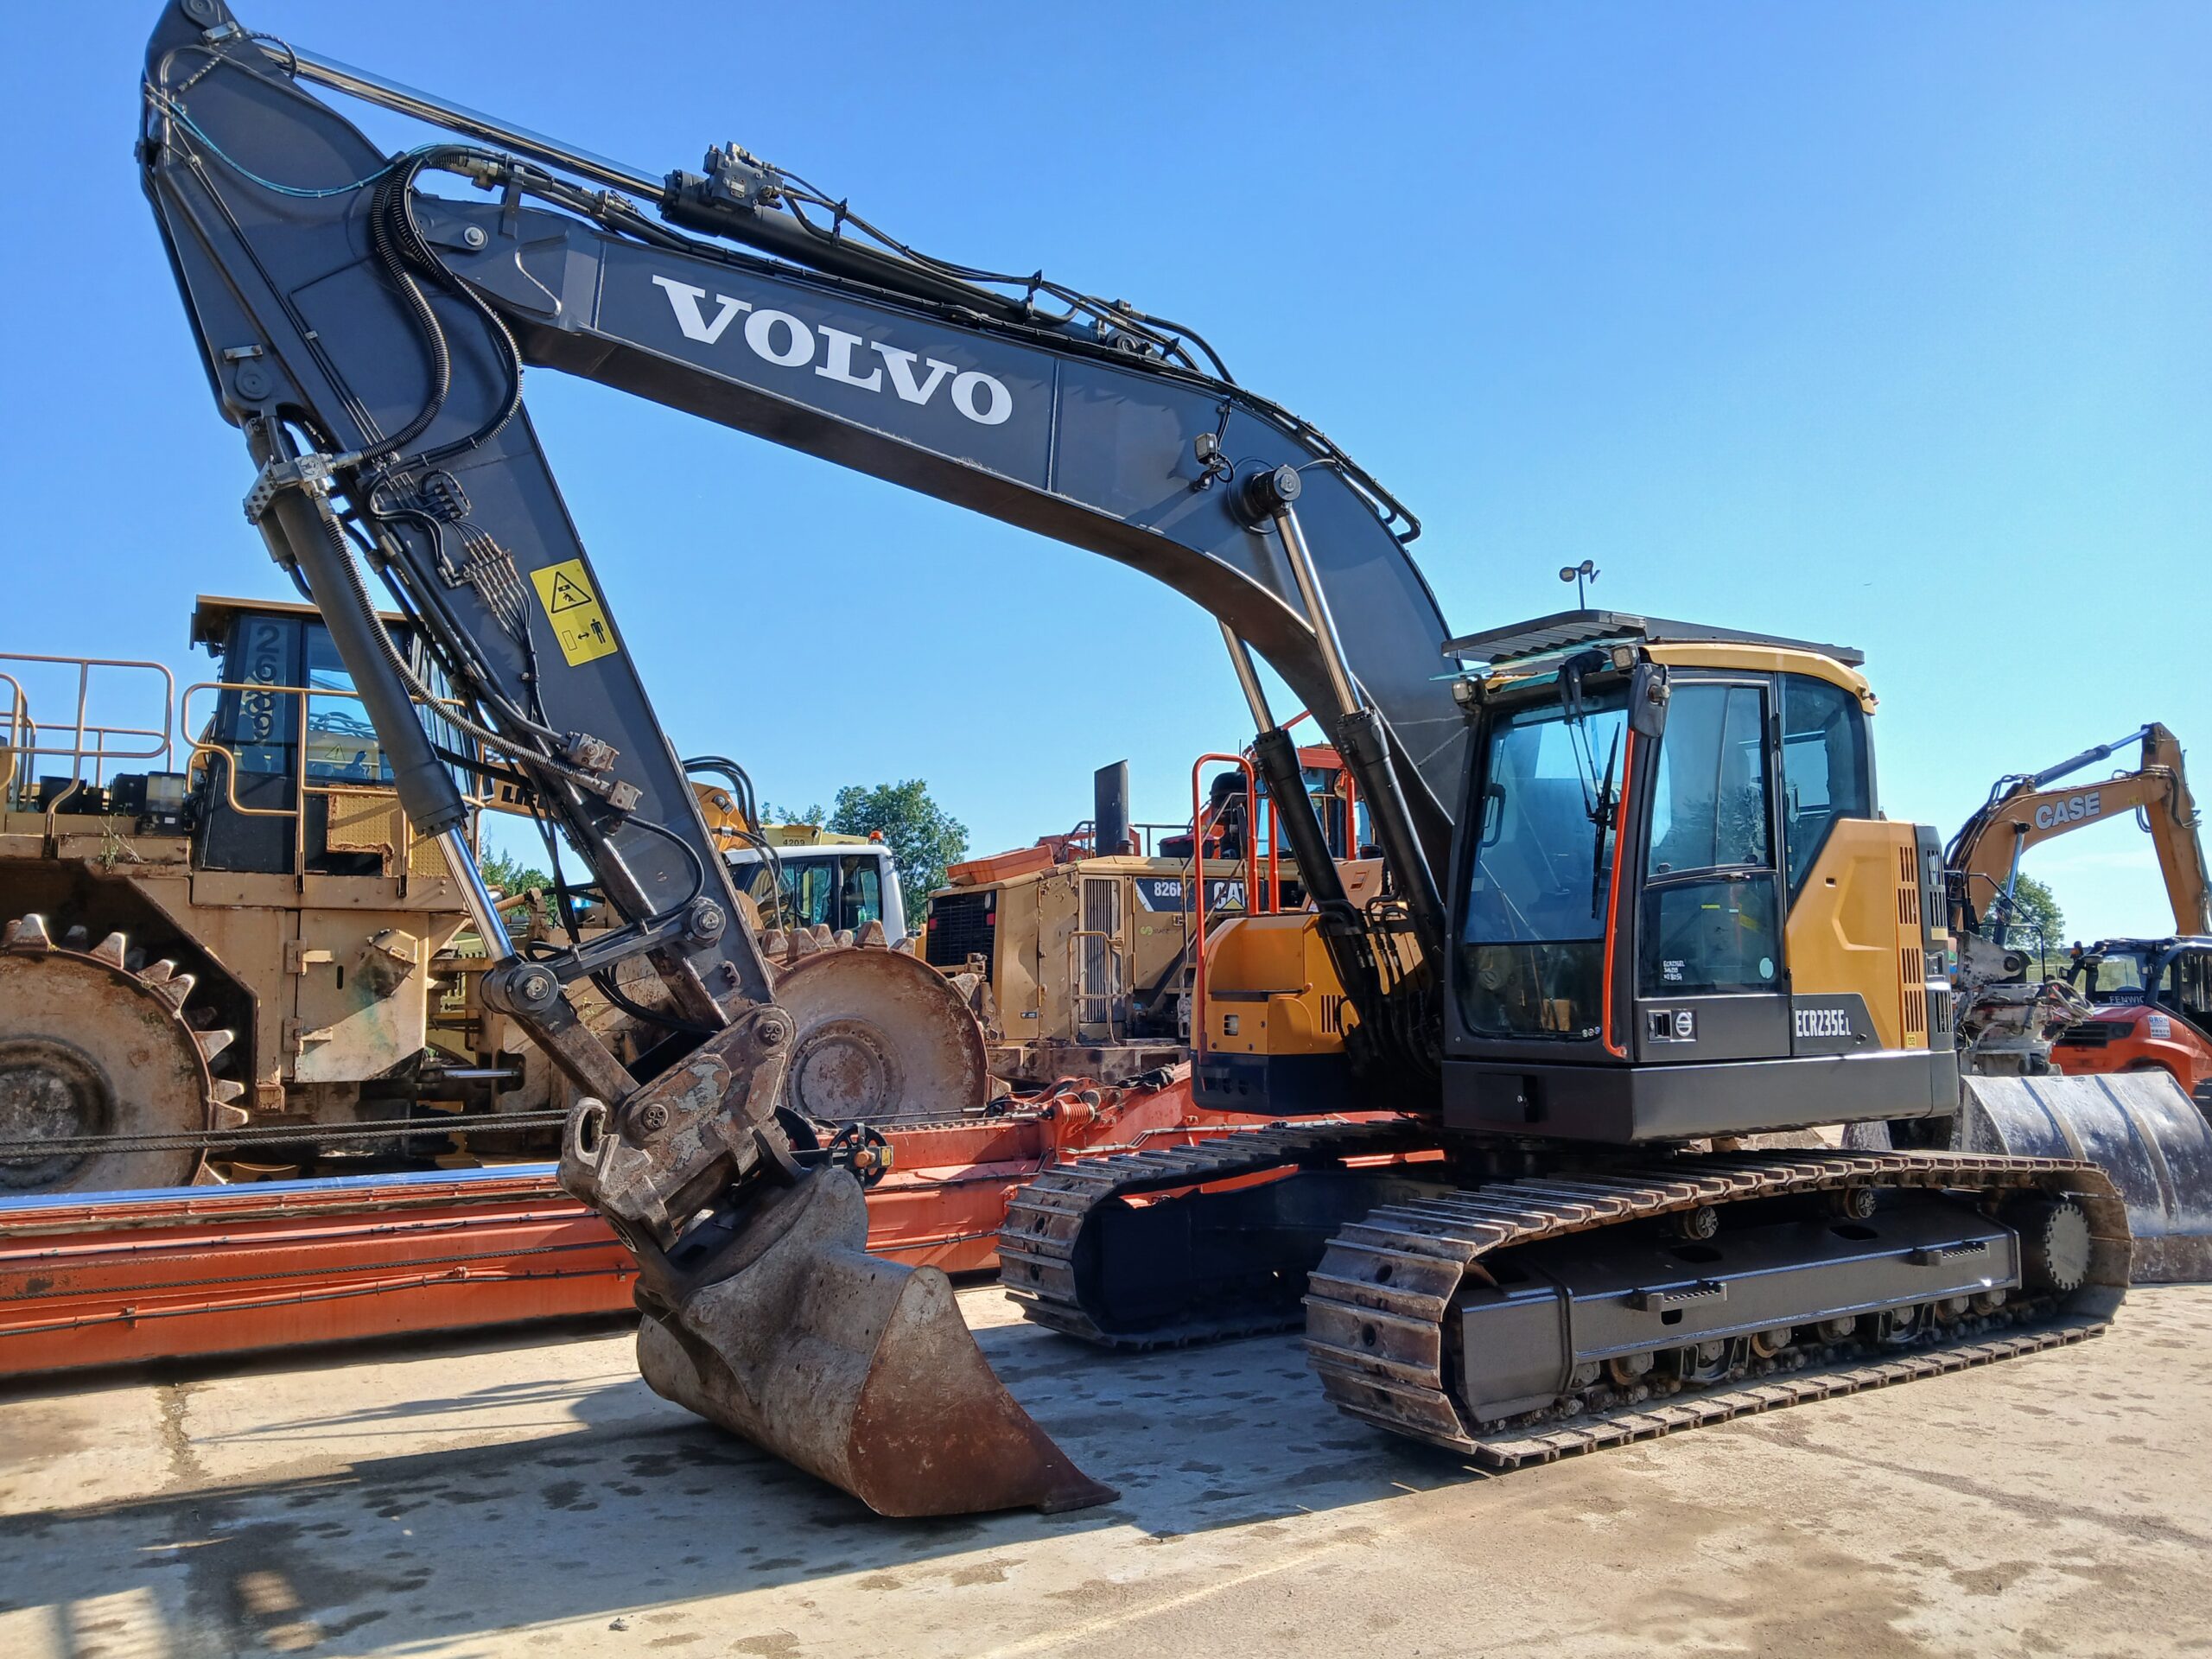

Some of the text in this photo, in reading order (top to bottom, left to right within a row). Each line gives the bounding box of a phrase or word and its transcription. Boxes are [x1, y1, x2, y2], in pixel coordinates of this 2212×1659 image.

[652, 274, 1014, 426] VOLVO
[2035, 790, 2101, 830] CASE
[1795, 1009, 1852, 1038] ECR235EL
